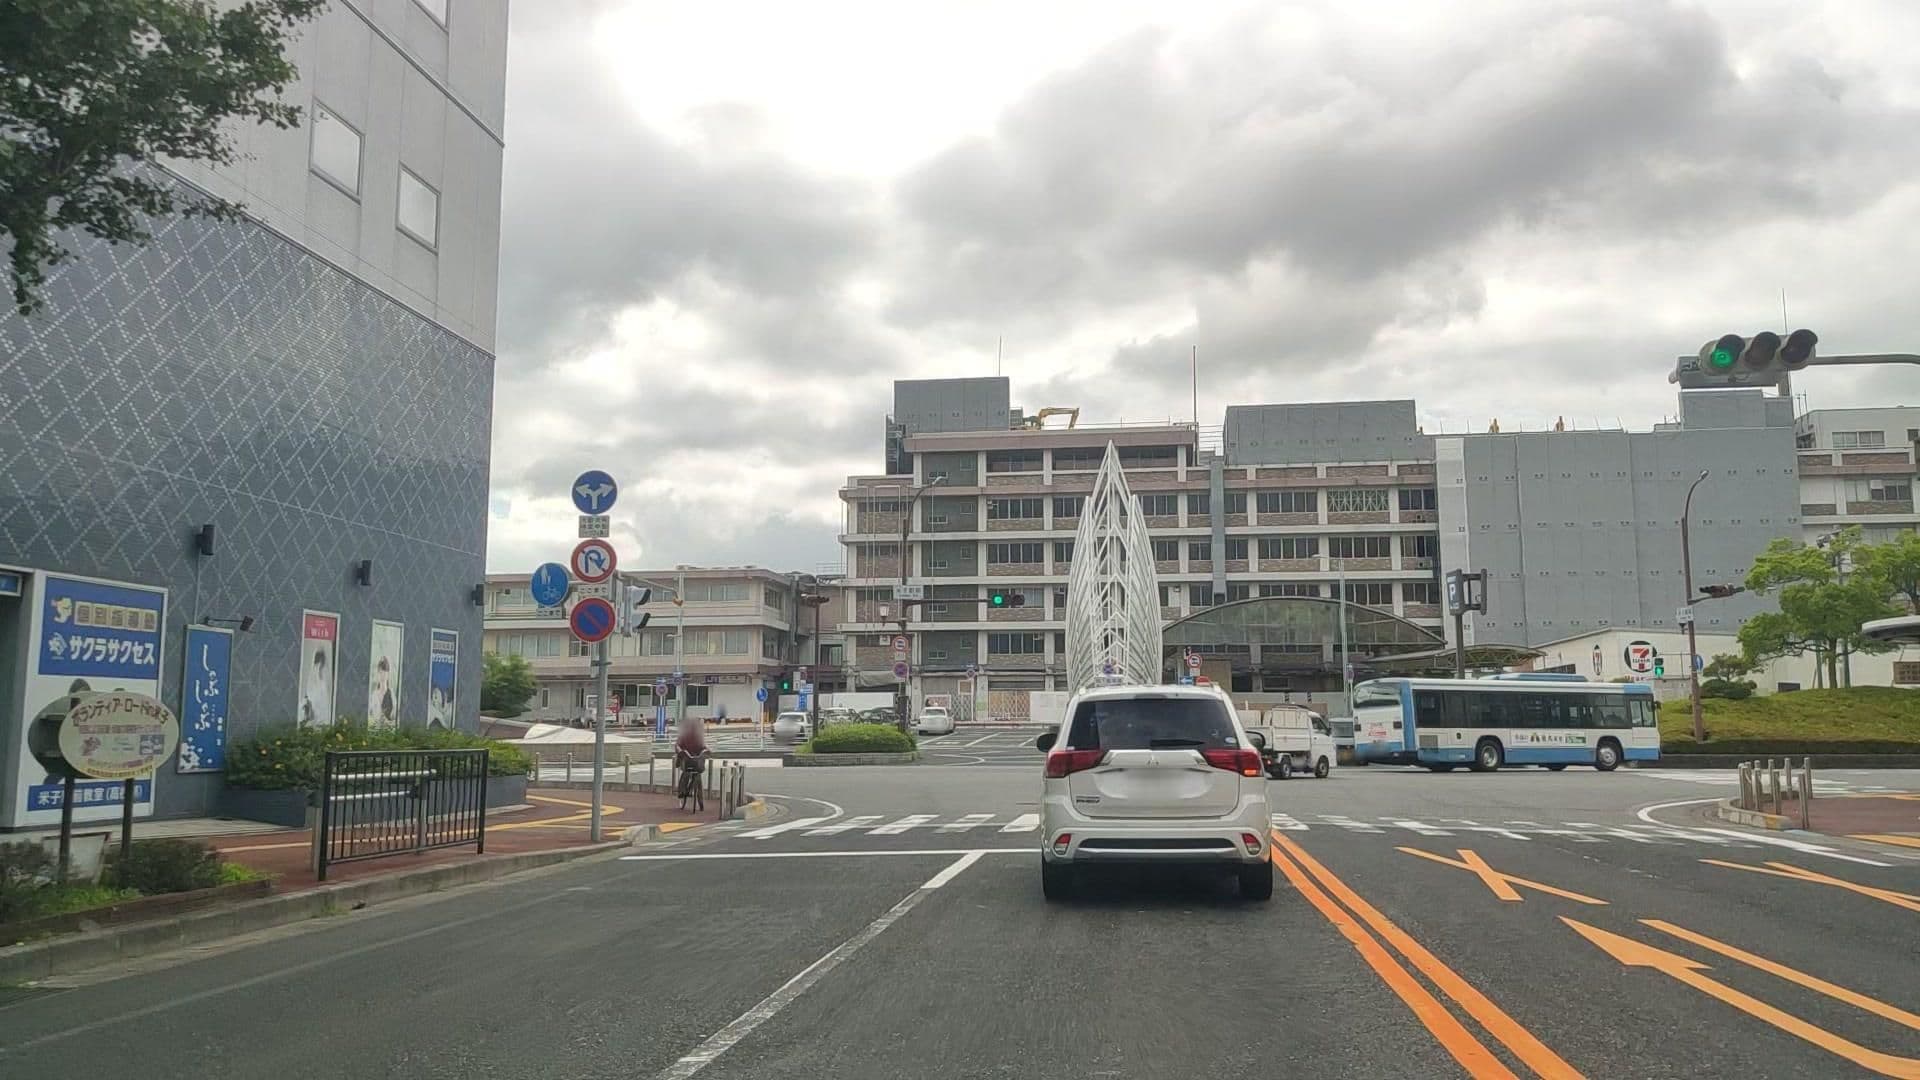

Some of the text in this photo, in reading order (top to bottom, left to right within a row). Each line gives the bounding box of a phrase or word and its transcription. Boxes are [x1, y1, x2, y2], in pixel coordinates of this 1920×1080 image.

[69, 635, 155, 665] サクラサクセス
